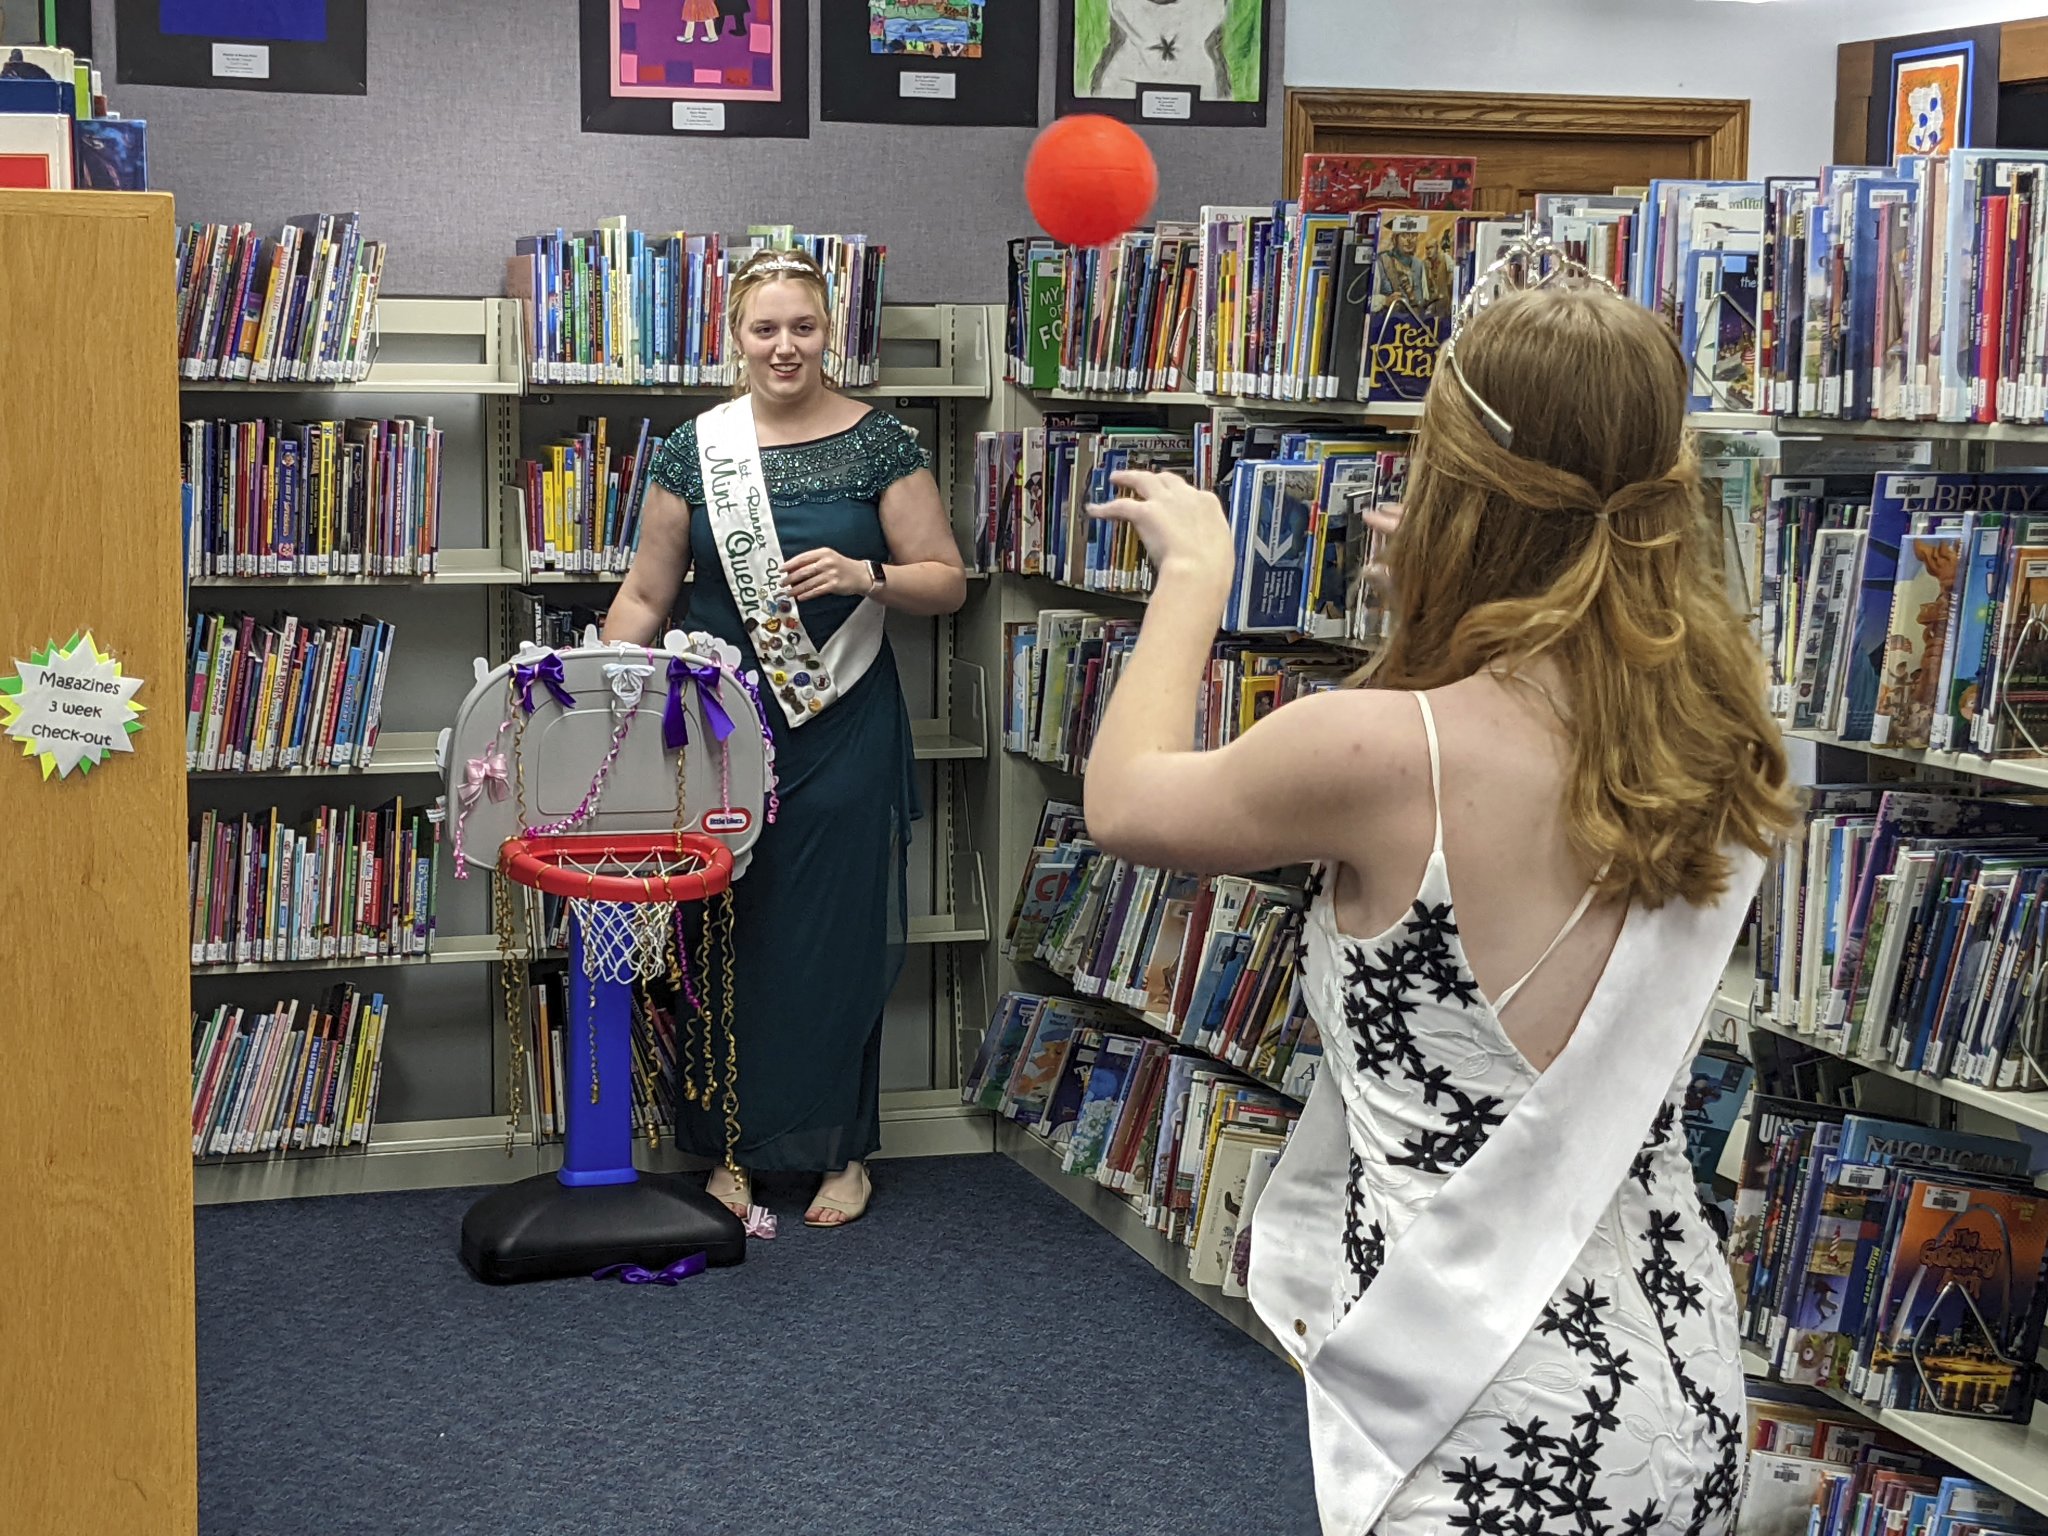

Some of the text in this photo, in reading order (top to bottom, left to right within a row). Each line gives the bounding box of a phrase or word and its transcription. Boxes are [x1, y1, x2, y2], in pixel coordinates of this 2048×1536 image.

[273, 251, 288, 310] BUILDING BIG
[1280, 243, 1288, 302] COUNTRIES
[1740, 276, 1756, 288] the
[1040, 286, 1060, 306] MY
[1279, 305, 1285, 316] OF
[268, 316, 277, 332] David
[1039, 320, 1063, 350] FO
[1394, 316, 1439, 347] real
[1370, 344, 1439, 388] pira
[705, 445, 761, 616] Mint Queen
[749, 486, 767, 549] Runner
[766, 557, 781, 592] Up
[1979, 600, 1996, 668] New Jersey
[216, 648, 226, 676] CRAFTY
[276, 622, 294, 701] Disney IDEAS BOOK
[39, 671, 121, 695] Magazines
[219, 689, 227, 706] BOOK
[344, 684, 353, 708] SNEAKY
[48, 700, 102, 718] 3 week
[31, 723, 112, 746] check-out
[281, 857, 291, 902] Crafty Dolls
[1796, 886, 1806, 951] Washington,
[1983, 942, 2005, 1001] Mississippi
[2011, 949, 2026, 979] Texas
[308, 1053, 317, 1069] LEGO
[302, 1070, 314, 1104] ANIMATION
[1754, 1200, 1769, 1256] Tennessee
[1773, 1204, 1787, 1252] Kentucky
[1862, 1247, 1881, 1304] Minnesota
